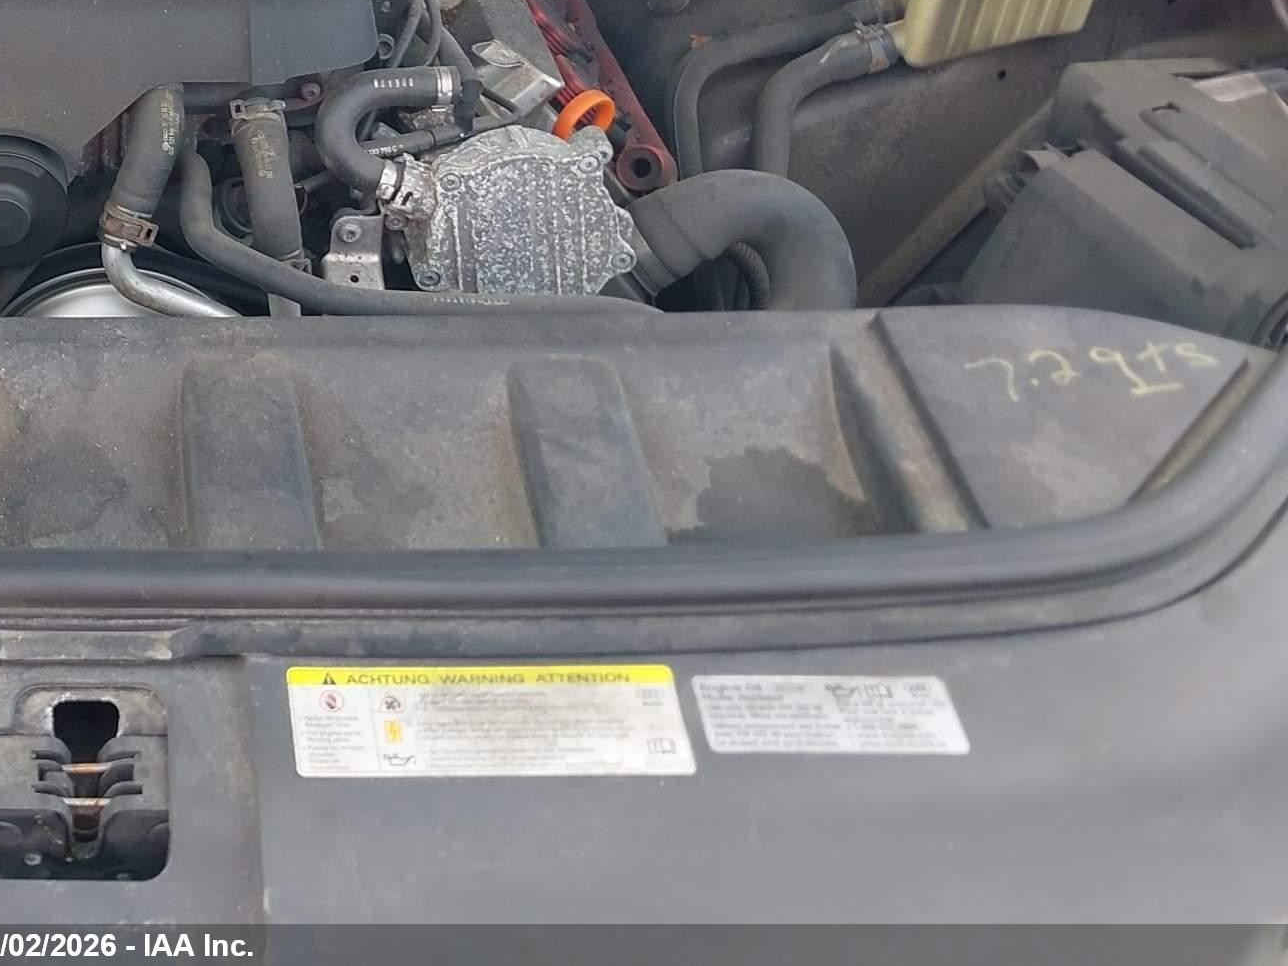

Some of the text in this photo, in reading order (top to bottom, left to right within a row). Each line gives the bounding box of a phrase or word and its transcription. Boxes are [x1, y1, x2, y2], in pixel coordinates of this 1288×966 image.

[345, 671, 631, 685] ACHTUNG WARNING ATTENTION
